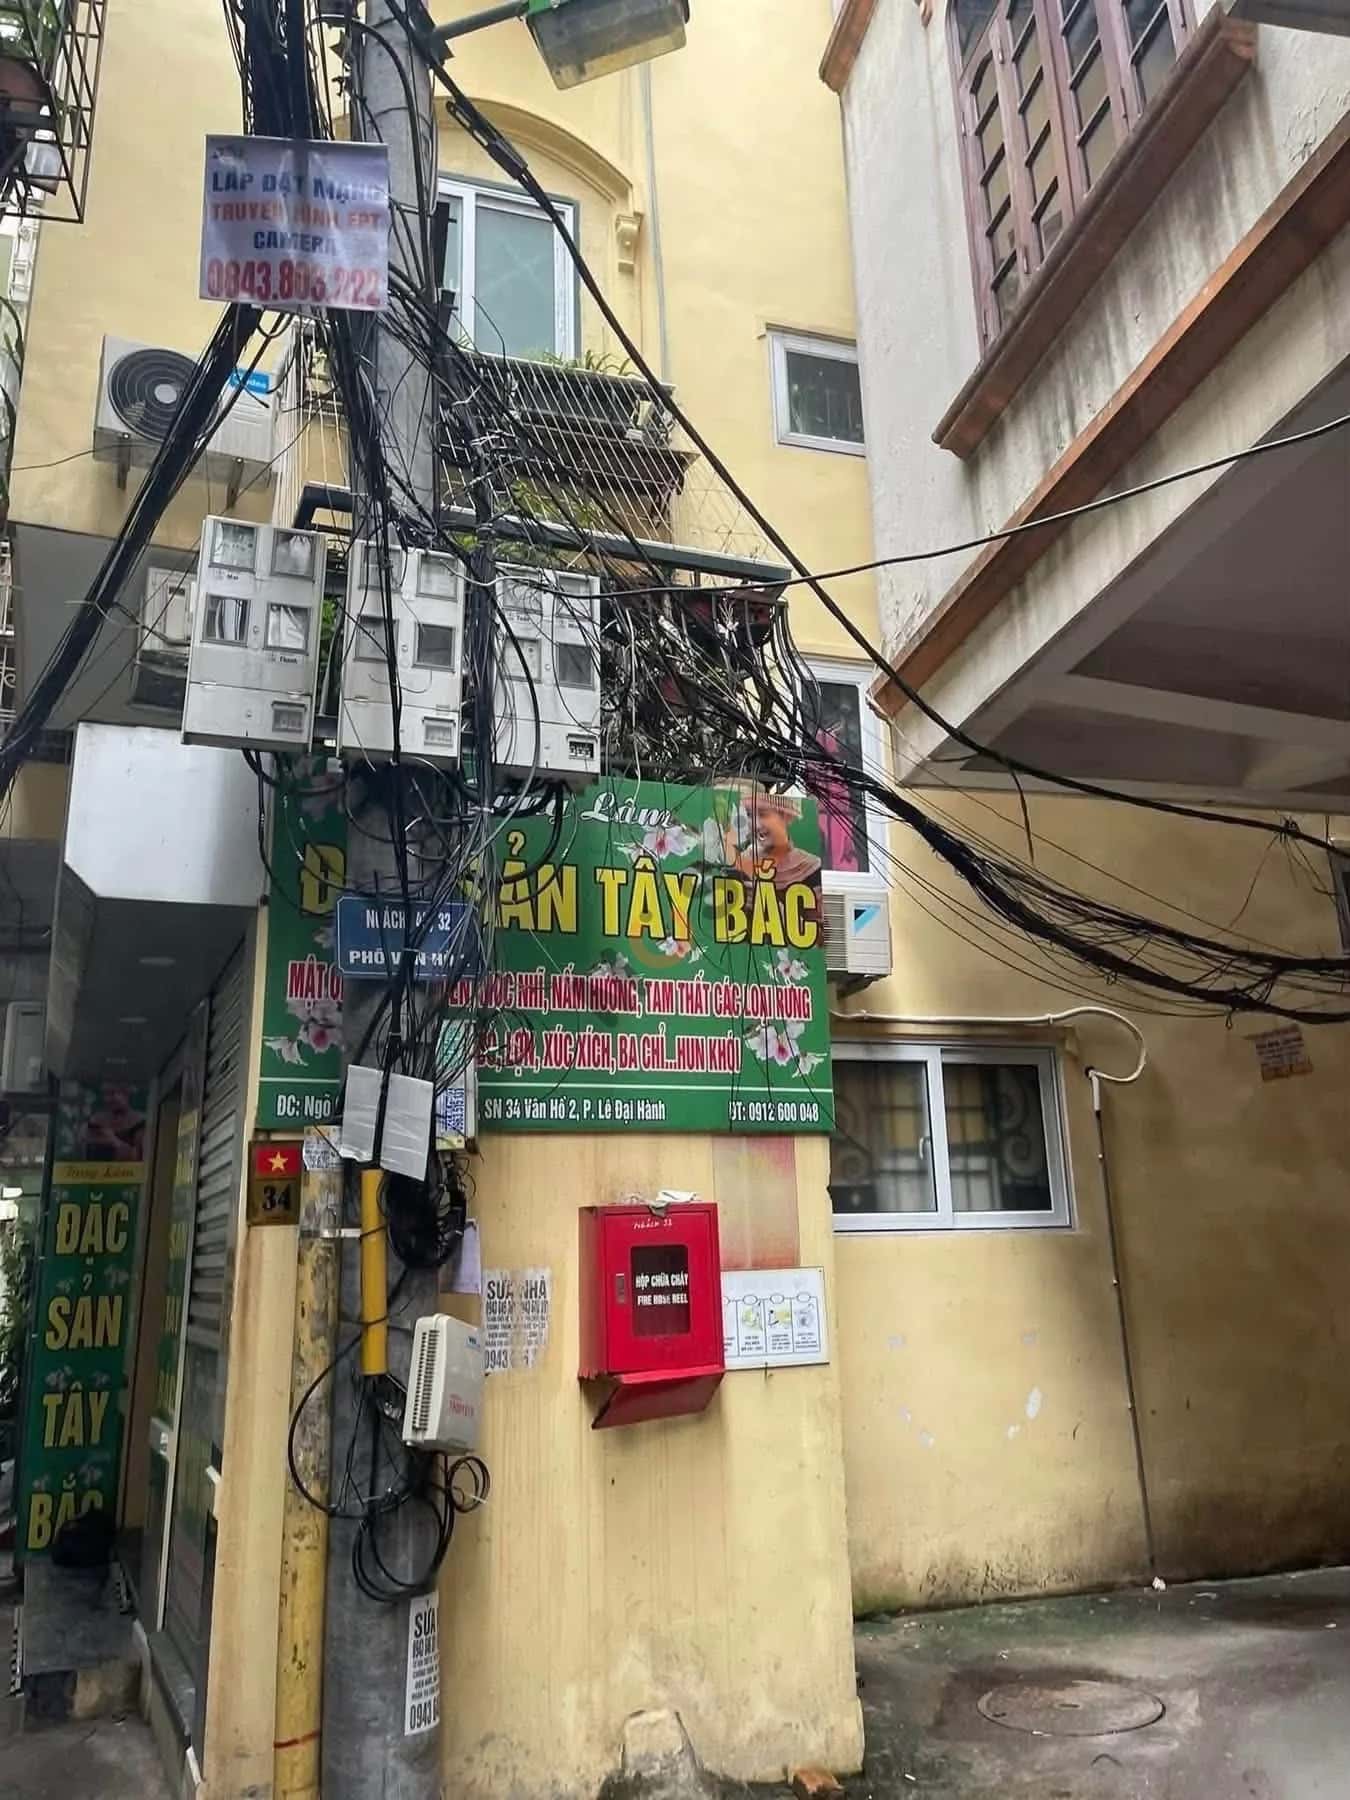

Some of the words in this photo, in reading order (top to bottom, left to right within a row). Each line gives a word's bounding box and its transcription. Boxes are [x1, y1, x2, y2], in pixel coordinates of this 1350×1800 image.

[461, 830, 577, 932] ẢN
[595, 856, 698, 942] TÂY
[713, 858, 818, 948] BẮC
[438, 913, 450, 931] 32
[391, 950, 425, 966] VN
[644, 979, 676, 1015] TAM
[712, 976, 741, 1018] CÁC
[542, 1024, 575, 1069] XÚC
[575, 1025, 616, 1075] XÍCH,
[617, 1033, 639, 1071] BA
[304, 1094, 331, 1119] Ngõ
[484, 1099, 502, 1119] SN
[505, 1100, 521, 1119] 34
[524, 1097, 547, 1119] Vân
[550, 1095, 567, 1119] Hồ
[568, 1100, 580, 1122] 2,
[583, 1101, 595, 1119] P.
[598, 1099, 612, 1119] Lê
[615, 1101, 634, 1125] Đại
[637, 1099, 666, 1121] Hành
[748, 1102, 775, 1122] 0912
[777, 1103, 797, 1122] 600
[799, 1103, 819, 1122] 048
[263, 1184, 292, 1211] 34
[56, 1191, 129, 1265] ĐẶC
[45, 1274, 123, 1351] SẢN
[637, 1294, 652, 1306] FIRE
[672, 1293, 689, 1304] REEL
[42, 1380, 109, 1449] TÂY
